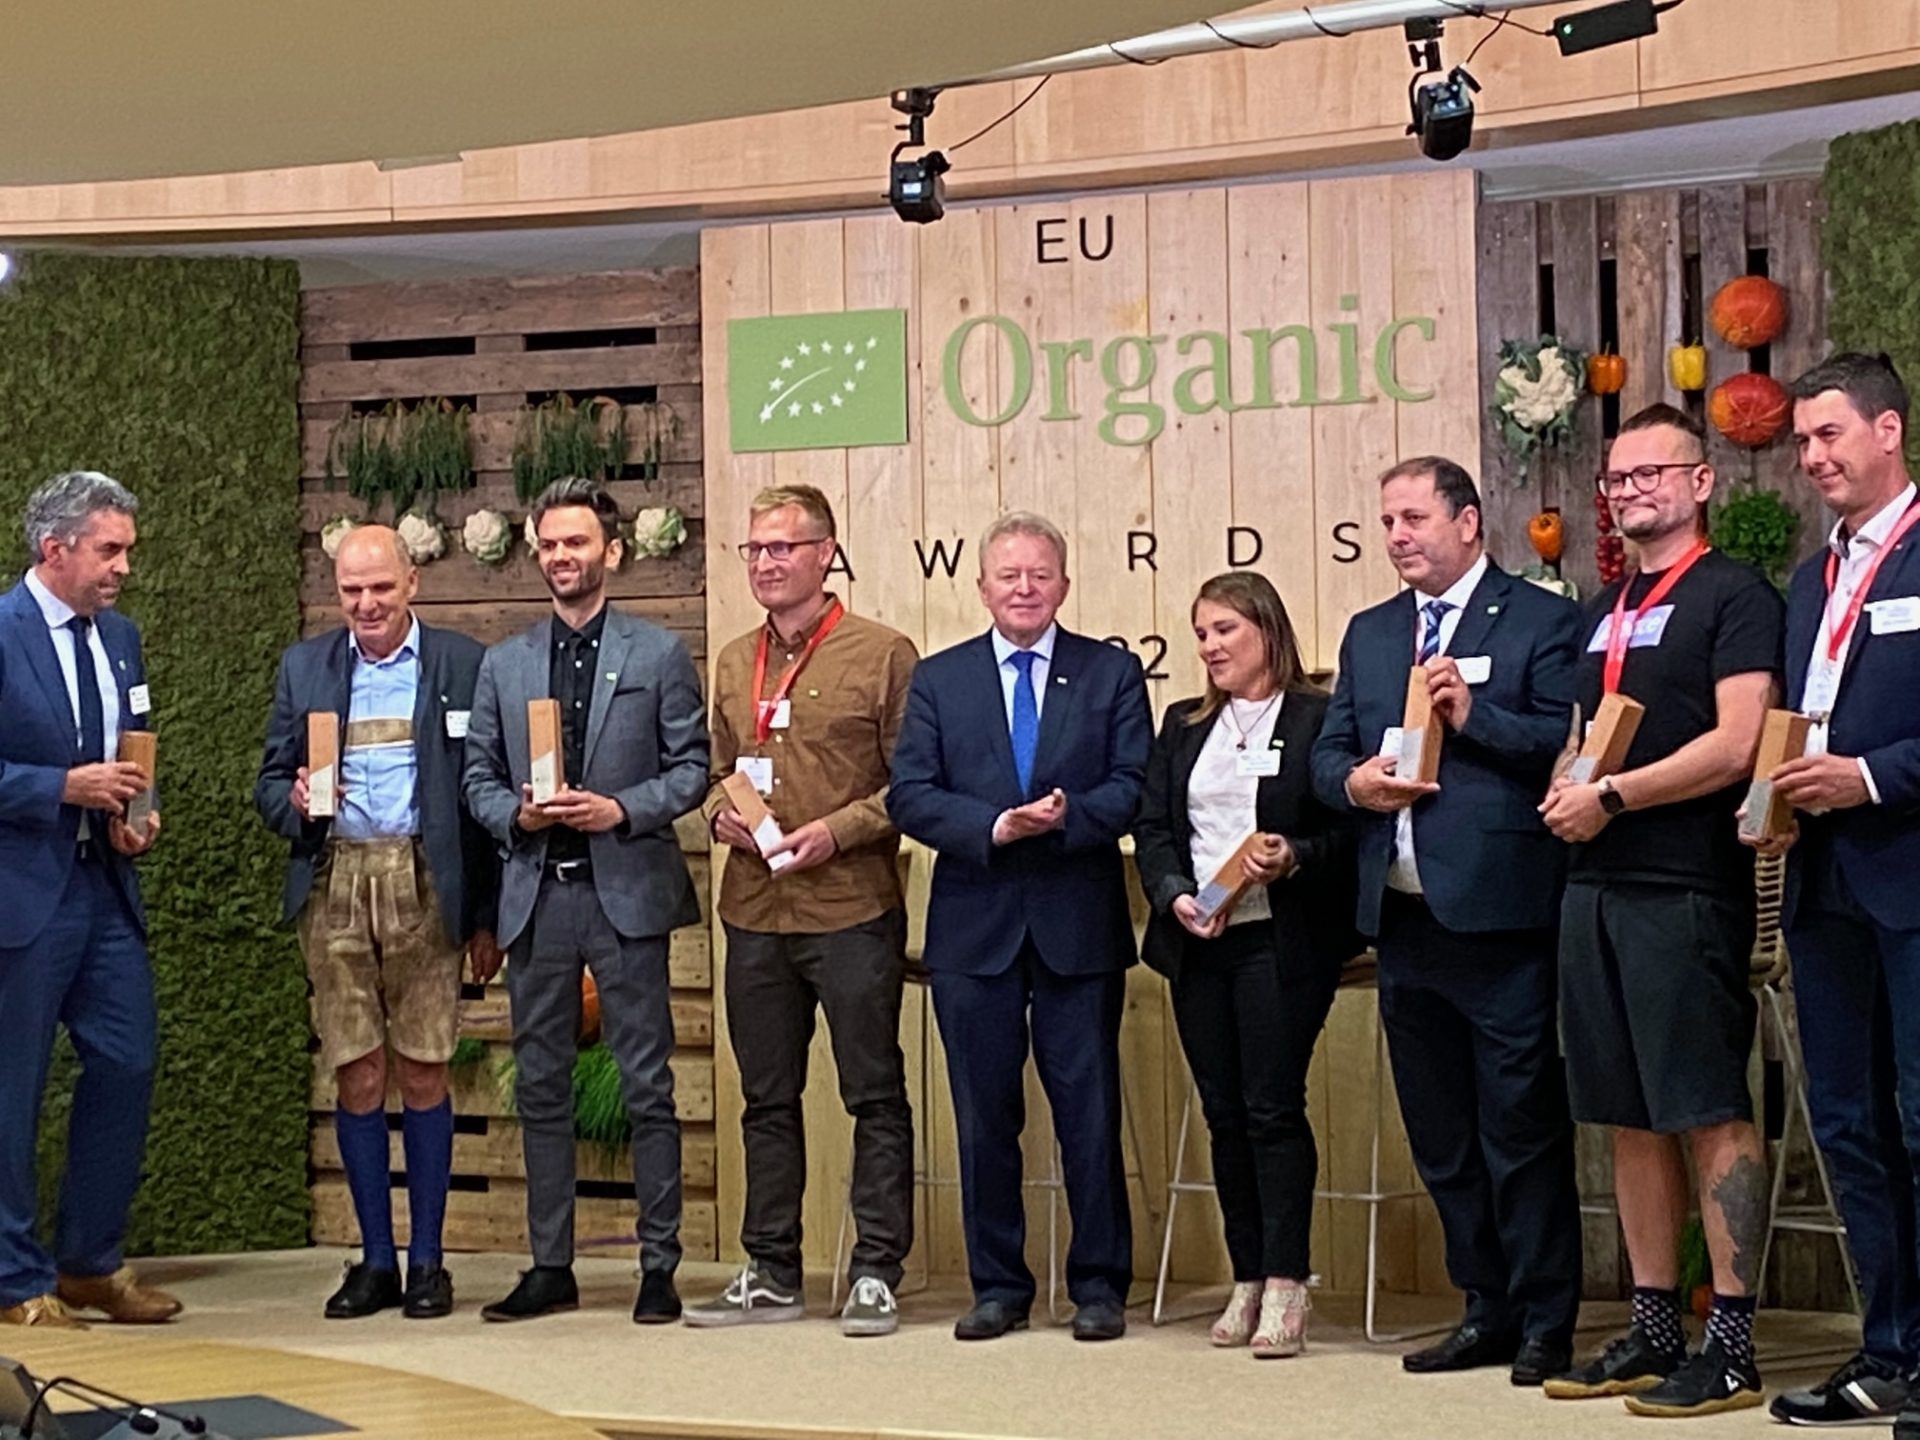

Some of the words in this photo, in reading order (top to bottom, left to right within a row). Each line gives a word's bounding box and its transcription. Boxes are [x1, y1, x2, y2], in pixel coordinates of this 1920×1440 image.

[1037, 214, 1113, 263] EU
[941, 293, 1436, 447] Organic
[822, 522, 1362, 583] AWRDS
